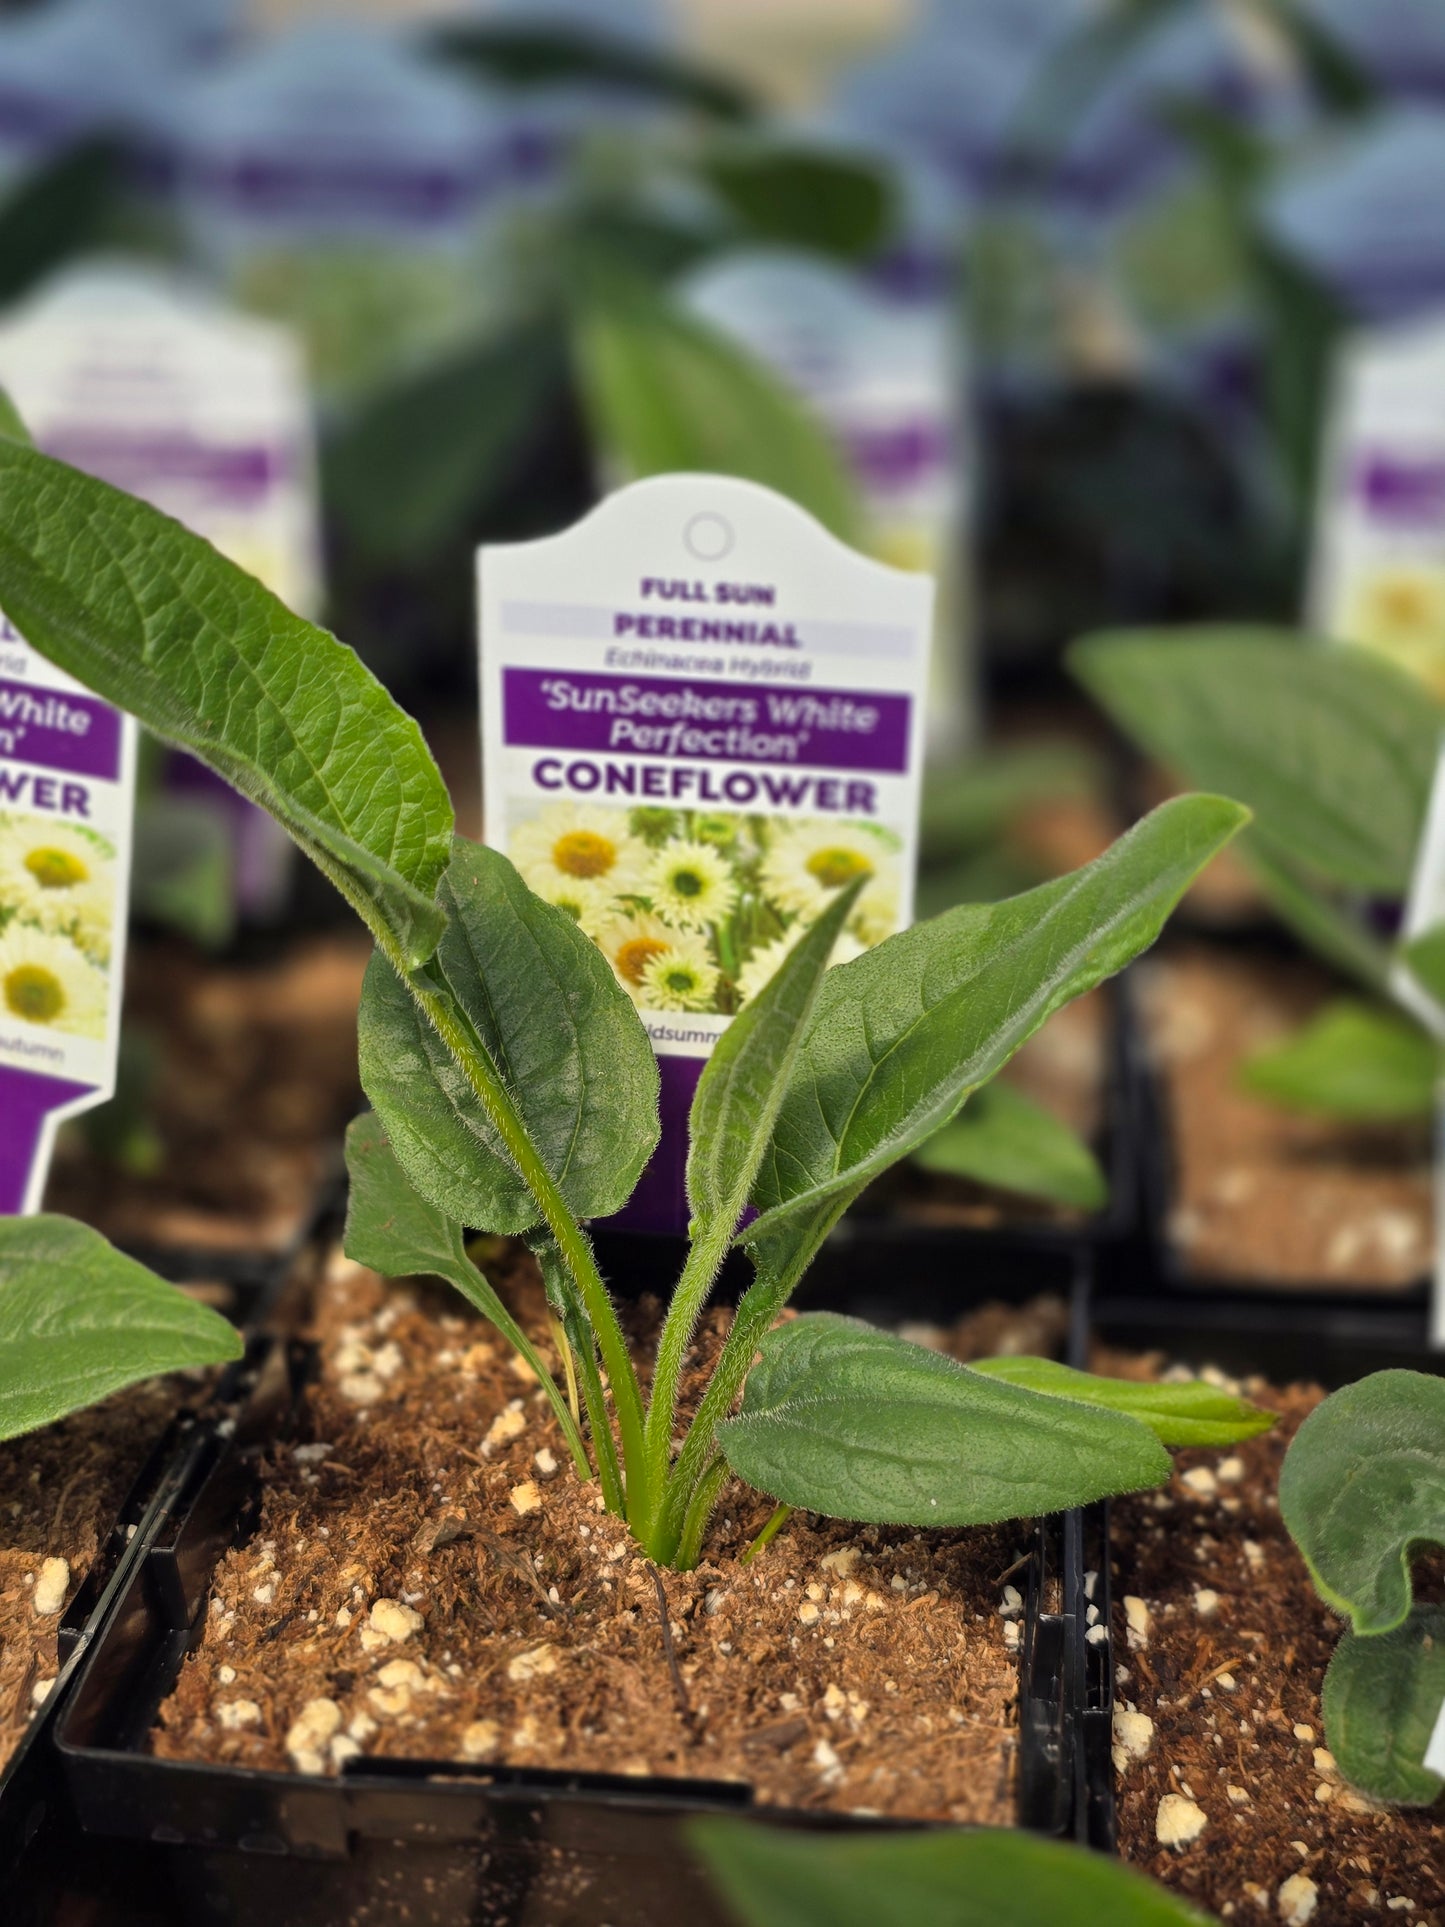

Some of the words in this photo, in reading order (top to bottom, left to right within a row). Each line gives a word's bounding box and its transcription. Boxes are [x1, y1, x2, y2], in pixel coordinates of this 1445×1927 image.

[641, 578, 708, 602] FULL
[714, 582, 775, 607] SUN
[613, 614, 802, 648] PERENNIAL
[604, 646, 725, 674] Echinacea
[766, 694, 878, 732] White
[533, 758, 877, 814] CONEFLOWER
